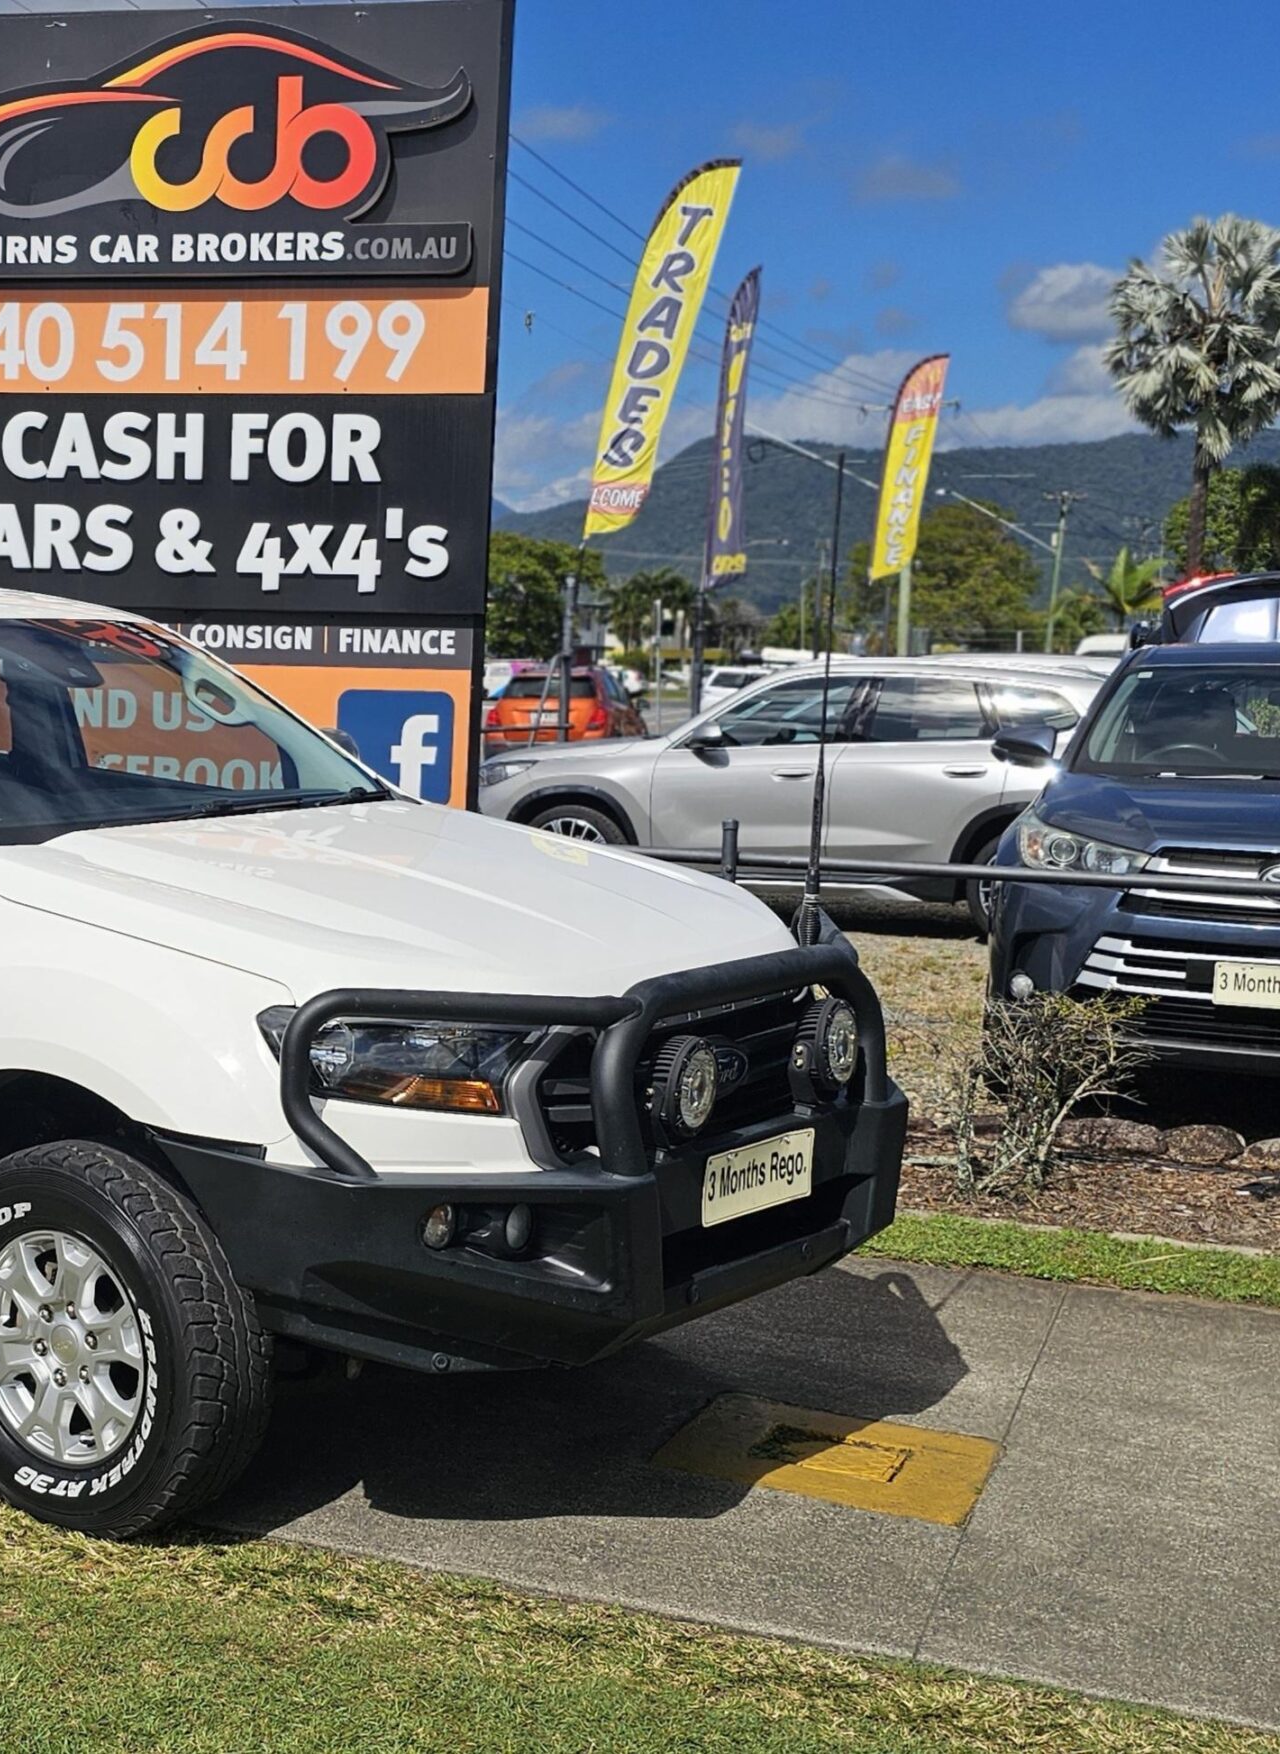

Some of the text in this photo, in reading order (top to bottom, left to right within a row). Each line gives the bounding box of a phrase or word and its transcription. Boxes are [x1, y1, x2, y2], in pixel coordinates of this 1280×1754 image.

[89, 234, 159, 263] CAR
[95, 301, 247, 382] 514
[277, 300, 425, 382] 199
[1, 411, 382, 483] CASH FOR
[590, 487, 645, 508] LCOME
[884, 425, 927, 567] FINANCE
[154, 508, 217, 574] &
[189, 624, 313, 650] CONSIGN
[339, 628, 456, 655] FINANCE
[1219, 972, 1280, 993] 3 Month
[707, 1151, 807, 1202] 3 Months Rego.
